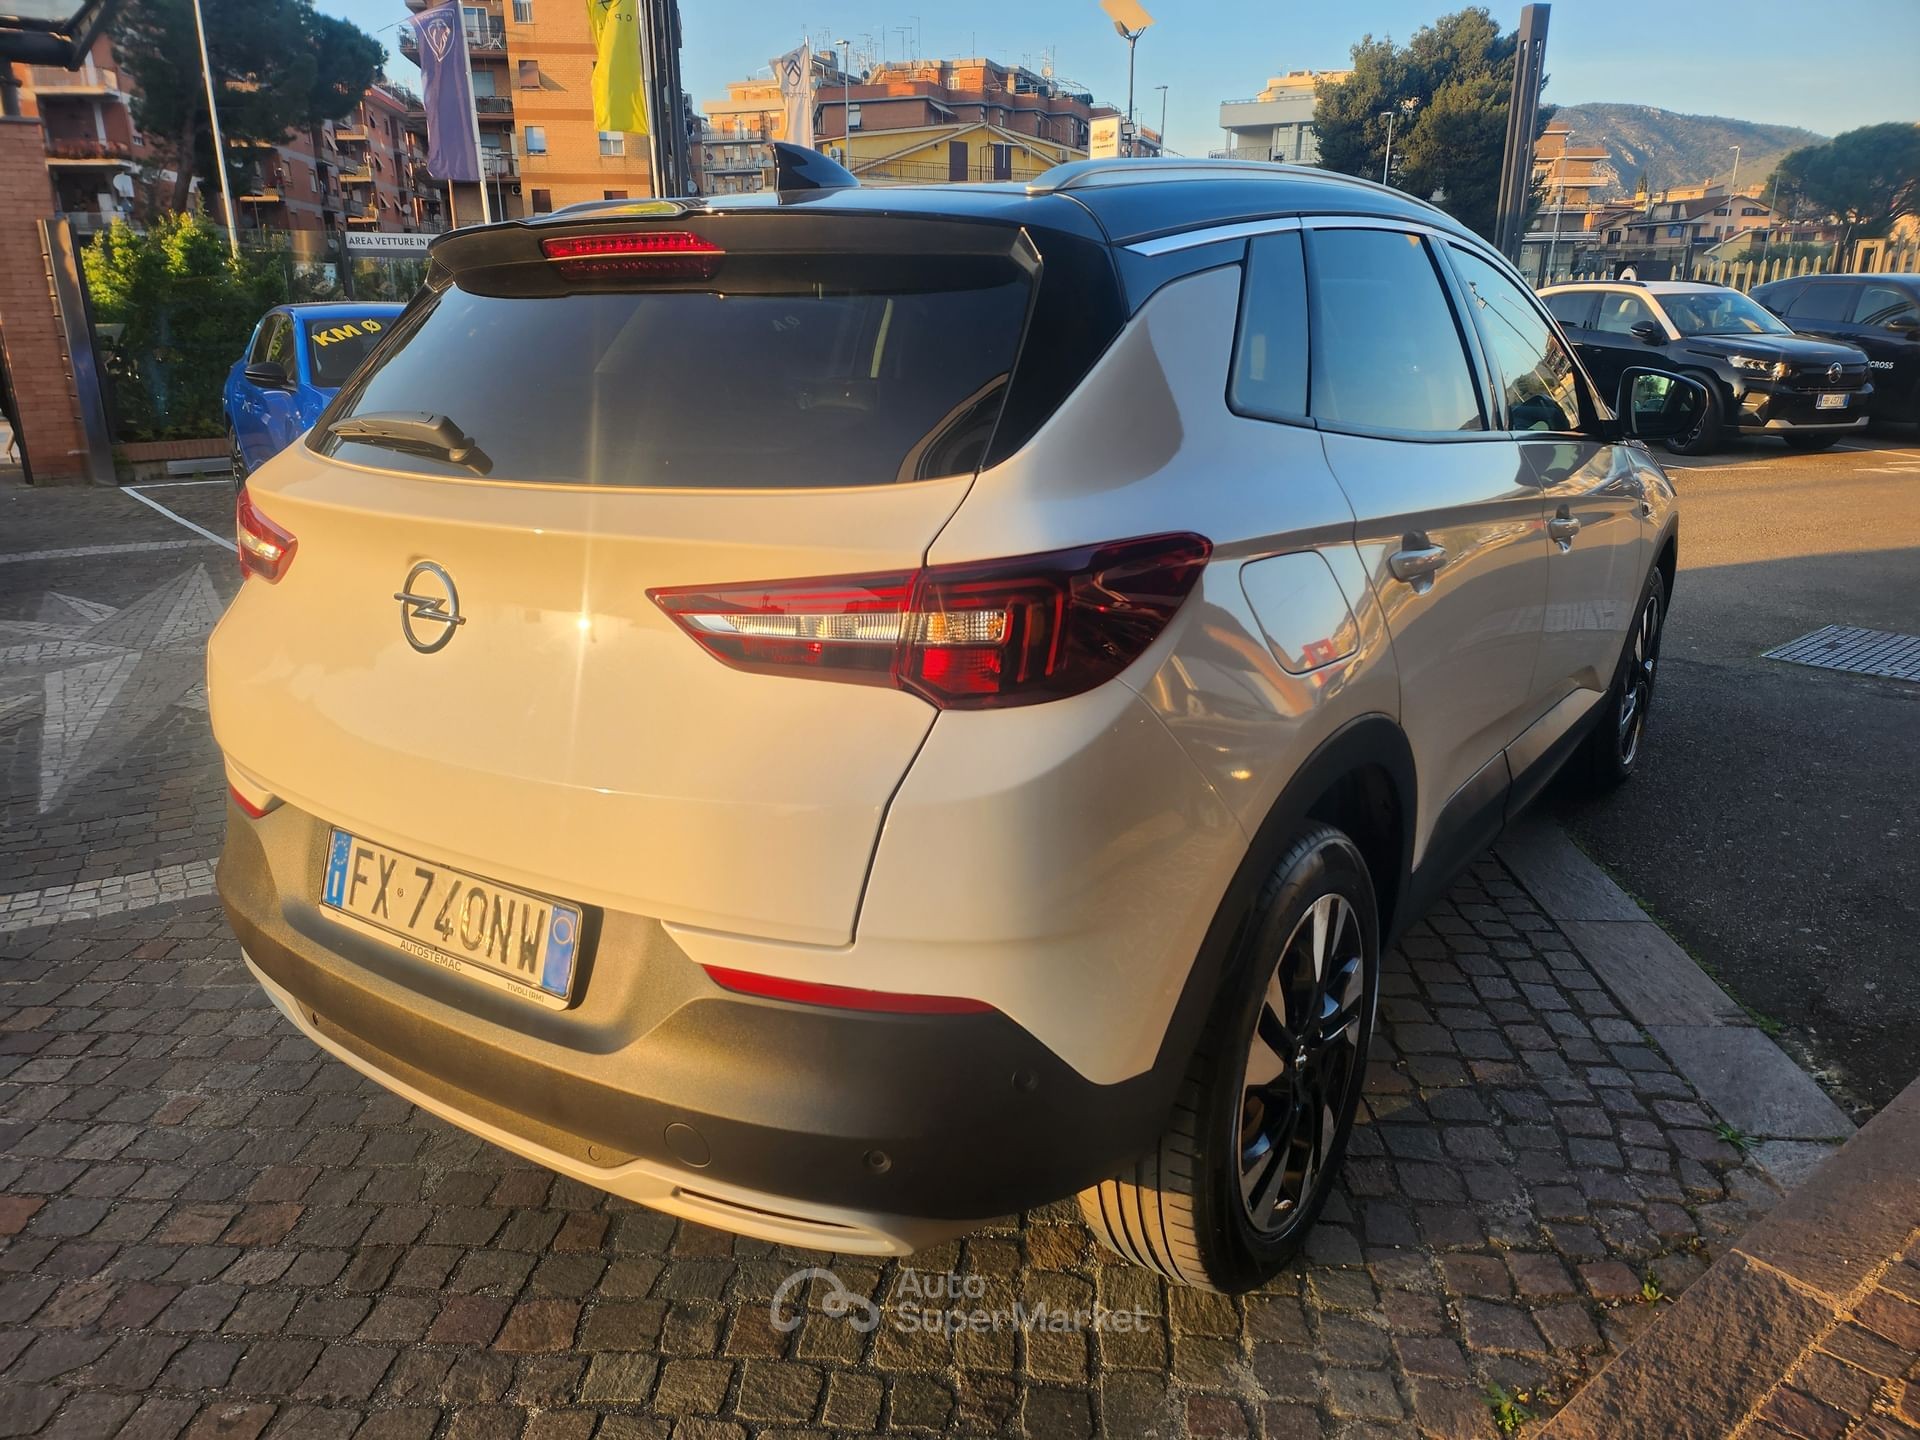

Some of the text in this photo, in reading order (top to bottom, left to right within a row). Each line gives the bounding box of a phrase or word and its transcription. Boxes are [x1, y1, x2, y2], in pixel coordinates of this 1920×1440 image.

[375, 238, 415, 246] VETTURE
[416, 238, 426, 246] IN
[311, 324, 362, 347] KM
[399, 940, 462, 972] AUTOSTEMAC
